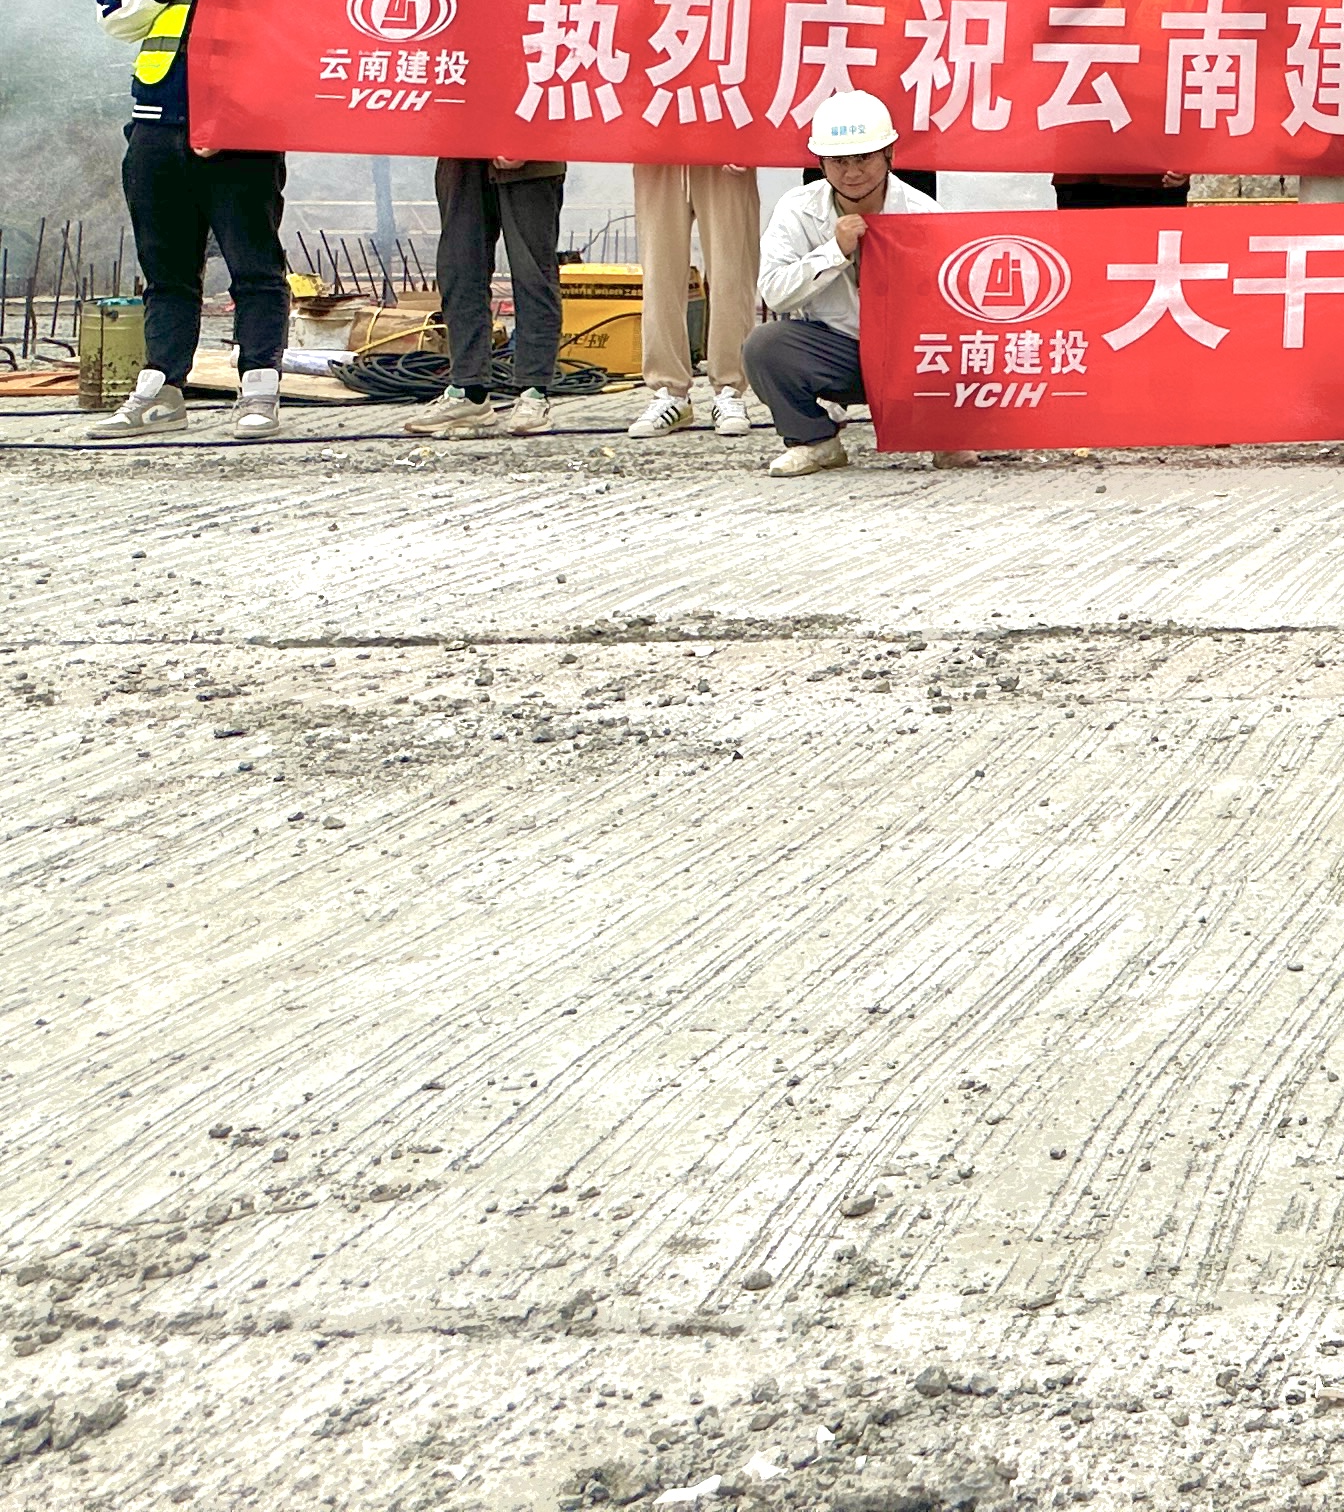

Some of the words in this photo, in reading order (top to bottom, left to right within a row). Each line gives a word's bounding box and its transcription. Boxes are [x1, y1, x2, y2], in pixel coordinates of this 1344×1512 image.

[319, 48, 469, 86] 云南建投
[348, 88, 432, 111] YCIH
[913, 329, 1089, 375] 云南建投
[953, 382, 1048, 408] YCIH
